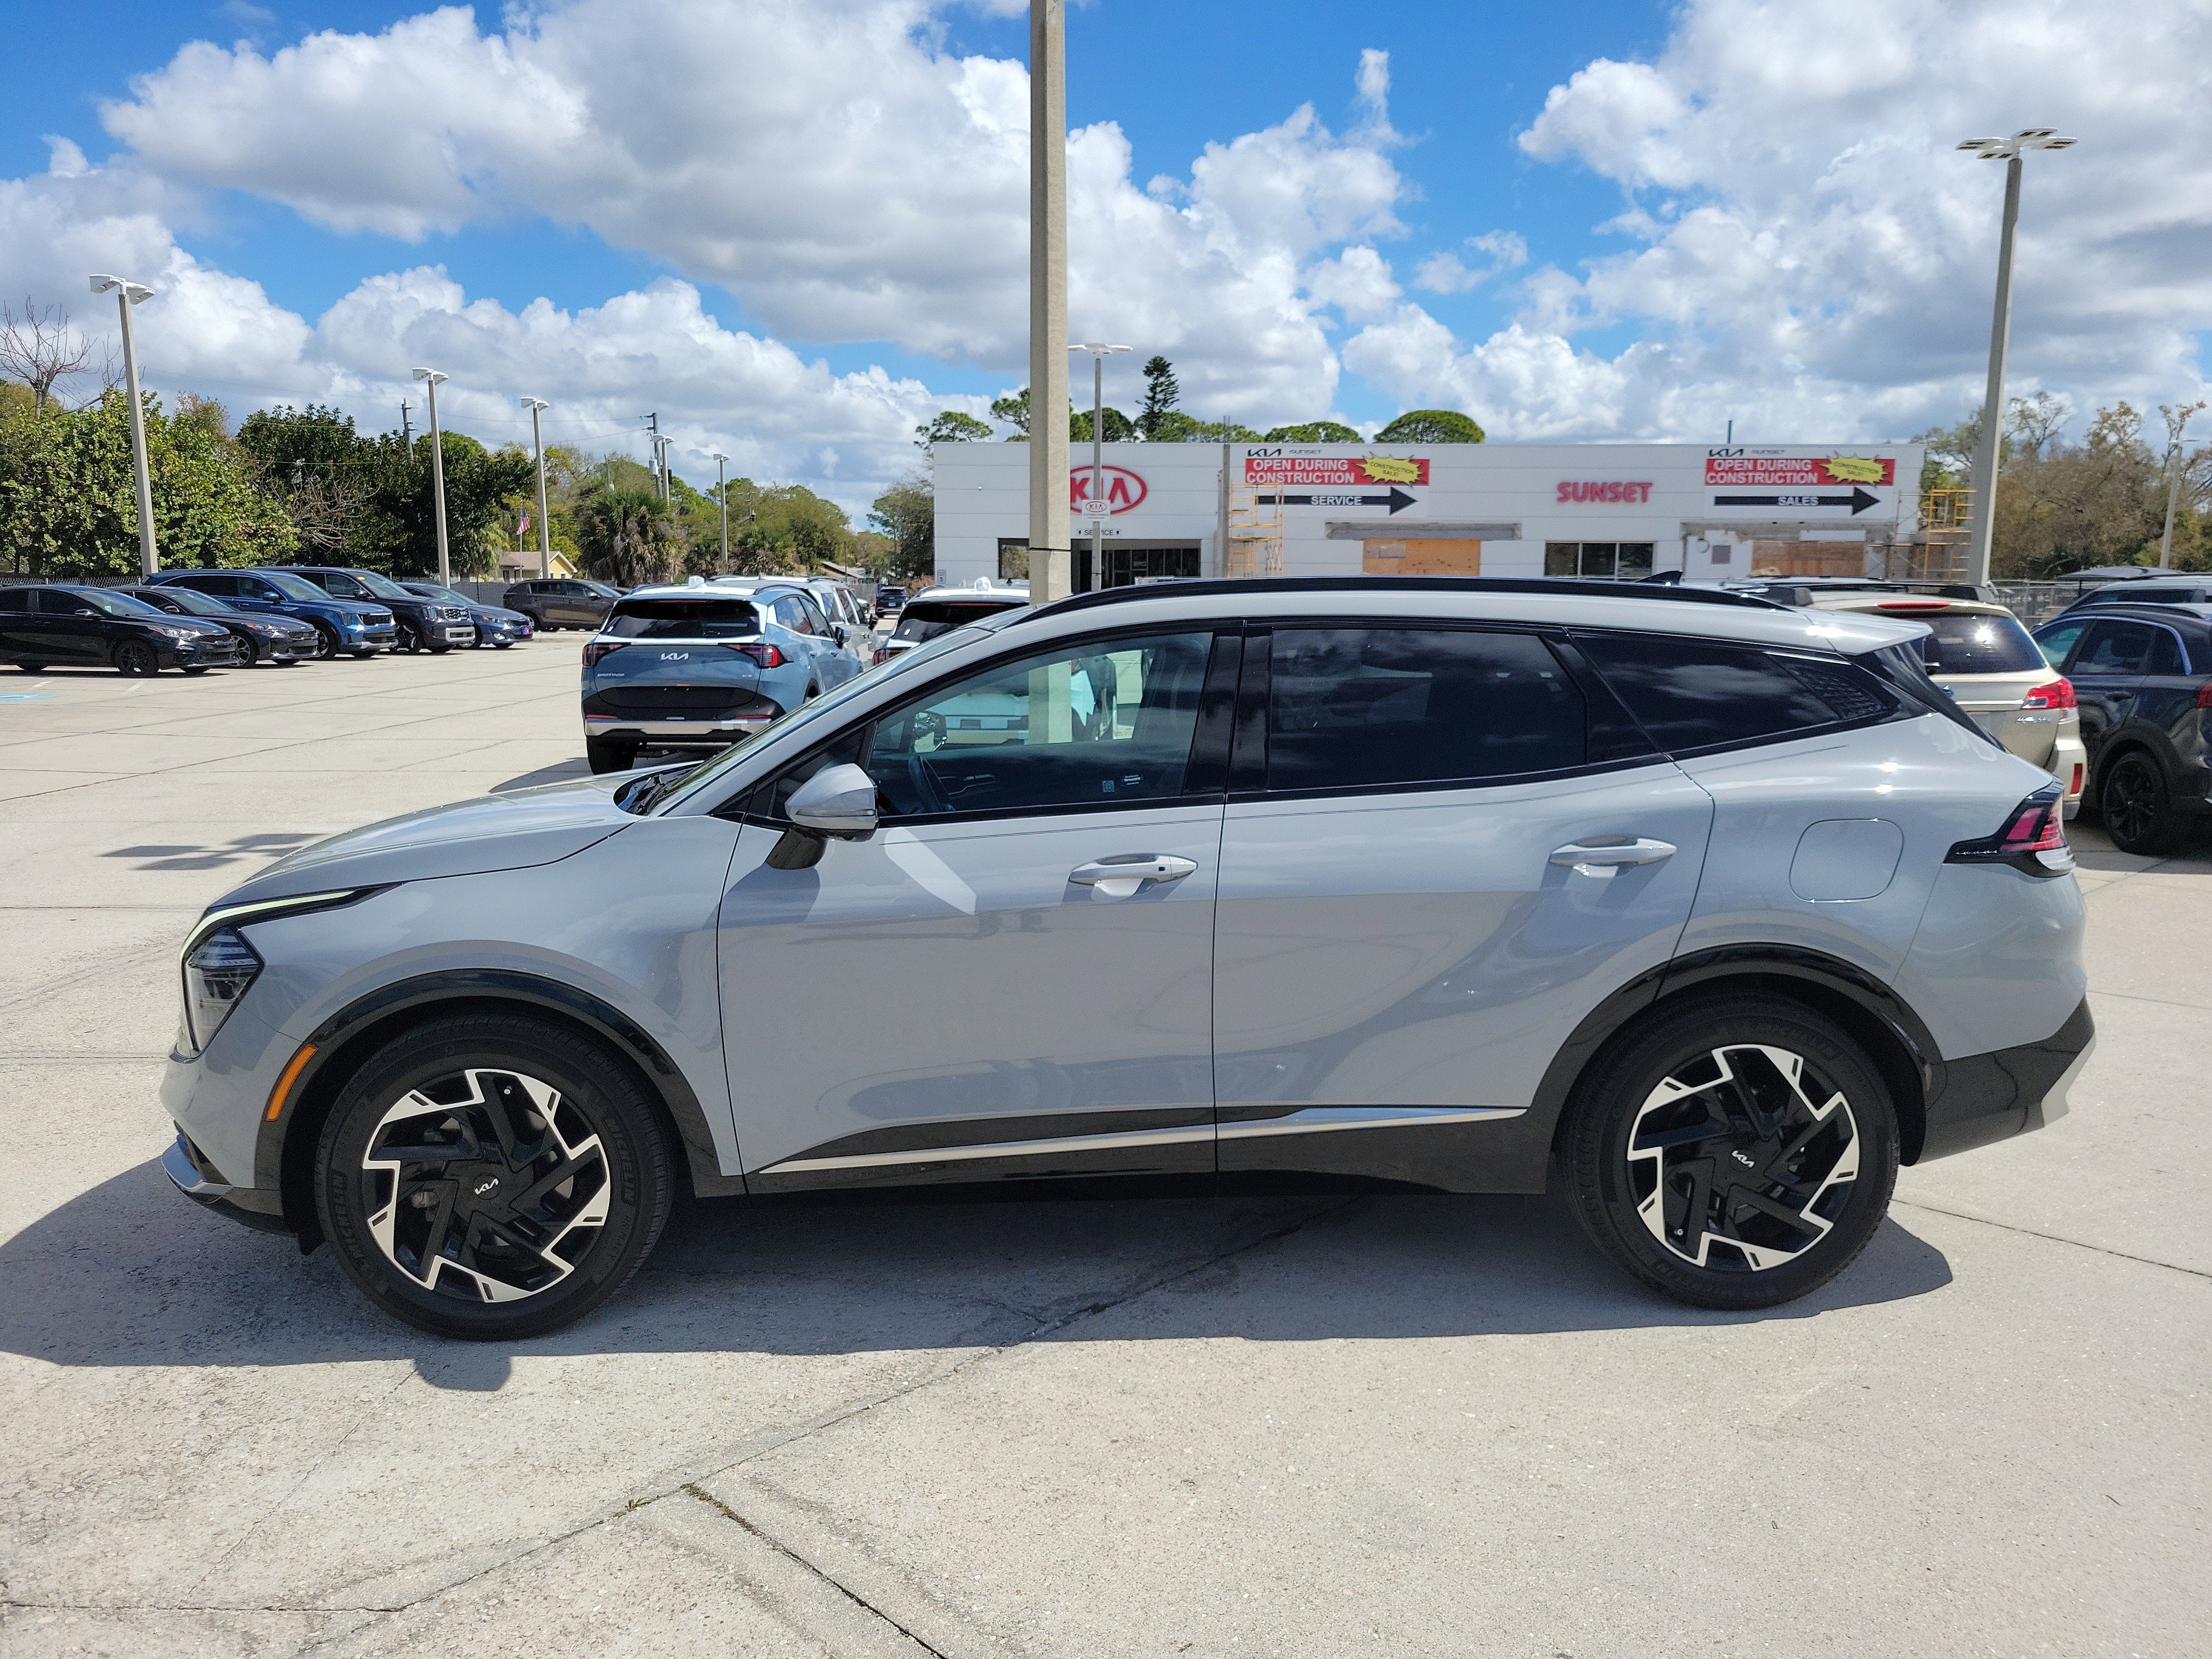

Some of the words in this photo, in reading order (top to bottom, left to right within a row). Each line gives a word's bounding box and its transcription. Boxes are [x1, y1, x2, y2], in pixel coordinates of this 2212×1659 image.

[1248, 448, 1282, 457] KIA
[1708, 448, 1745, 457] KIA
[1253, 459, 1291, 471] OPEN
[1295, 459, 1348, 471] DURING
[1713, 459, 1754, 471] OPEN
[1757, 459, 1812, 471] DURING
[1246, 472, 1355, 483] CONSTRUCTION
[1707, 472, 1818, 483] CONSTRUCTION
[1557, 481, 1653, 503] SUNSET
[1311, 496, 1363, 505] SERVICE
[1778, 496, 1819, 506] SALES
[661, 652, 690, 661] KIA
[1731, 1150, 1755, 1168] KIA
[475, 1178, 499, 1195] KIA
